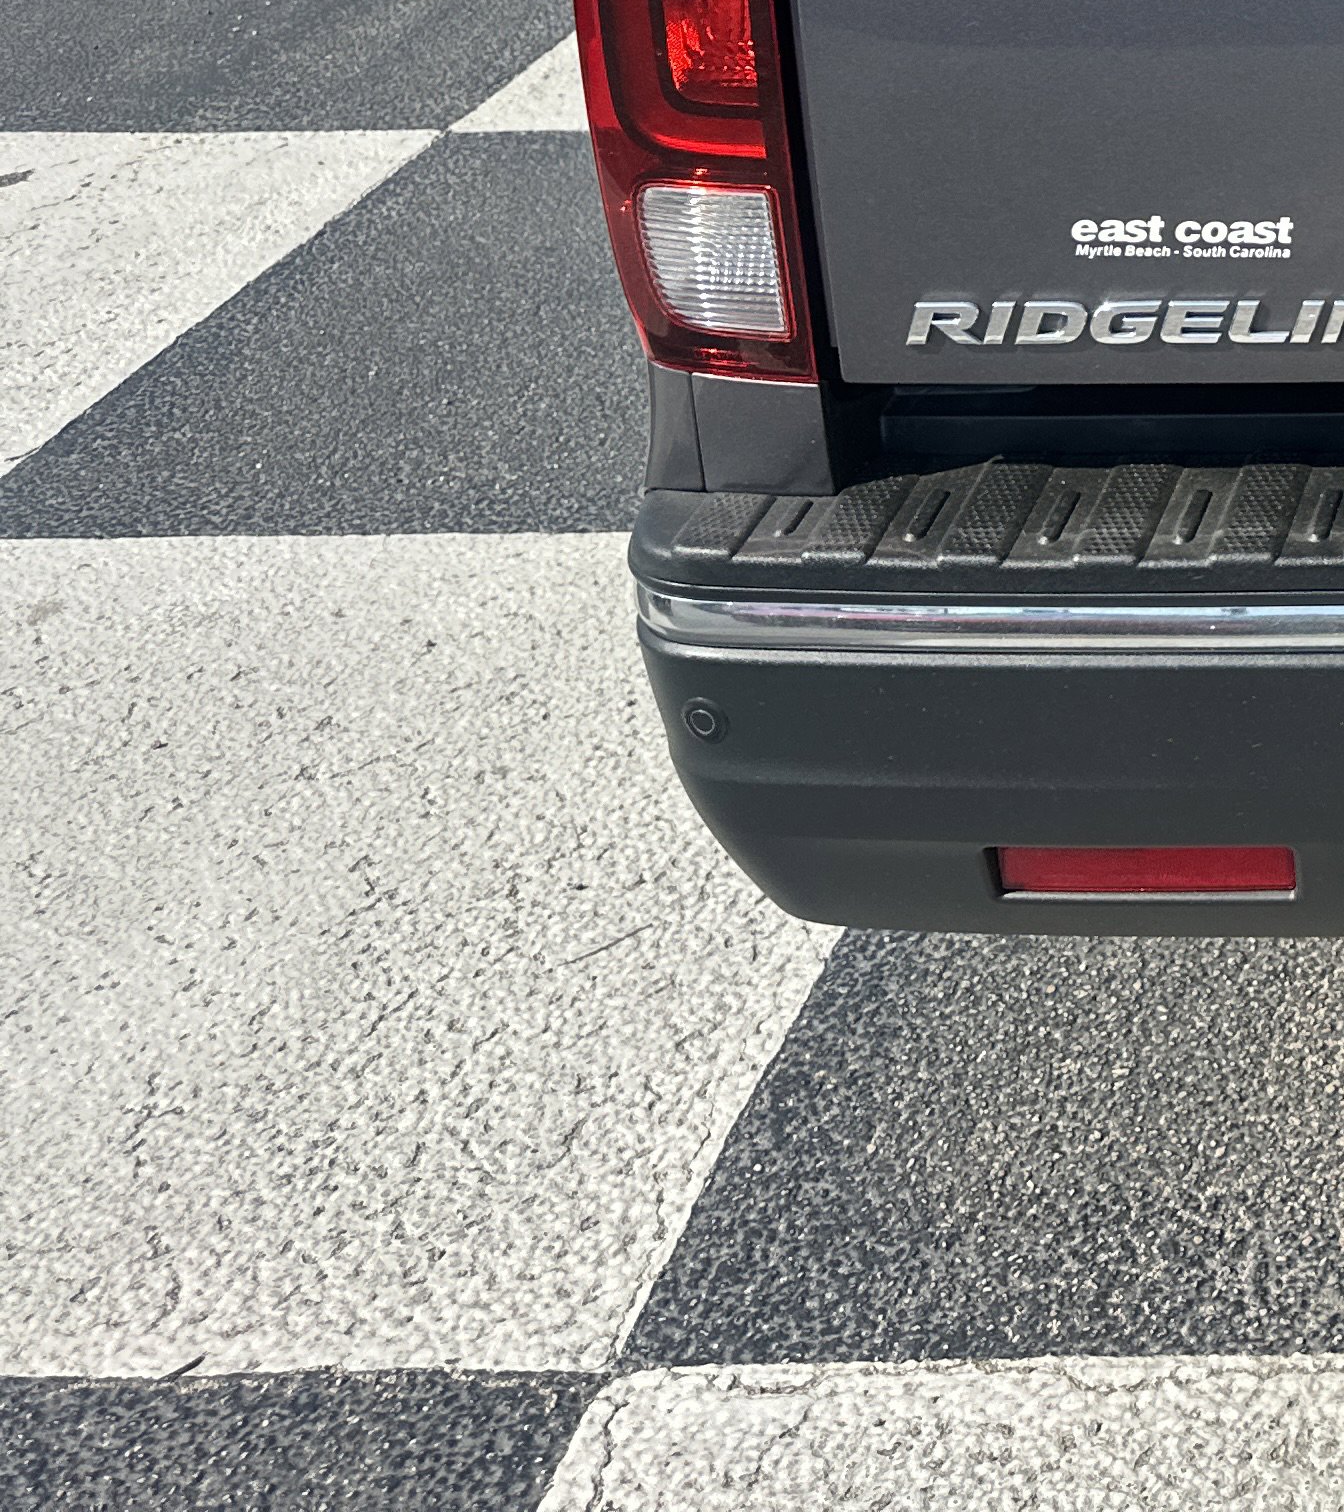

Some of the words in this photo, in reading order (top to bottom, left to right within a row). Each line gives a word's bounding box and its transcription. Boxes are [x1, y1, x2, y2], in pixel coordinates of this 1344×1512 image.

[1070, 215, 1165, 243] east
[1174, 216, 1294, 245] coast
[1075, 244, 1122, 259] Myrtle
[1124, 245, 1171, 257] Beach
[1182, 245, 1226, 258] South
[1229, 245, 1291, 259] Carolina
